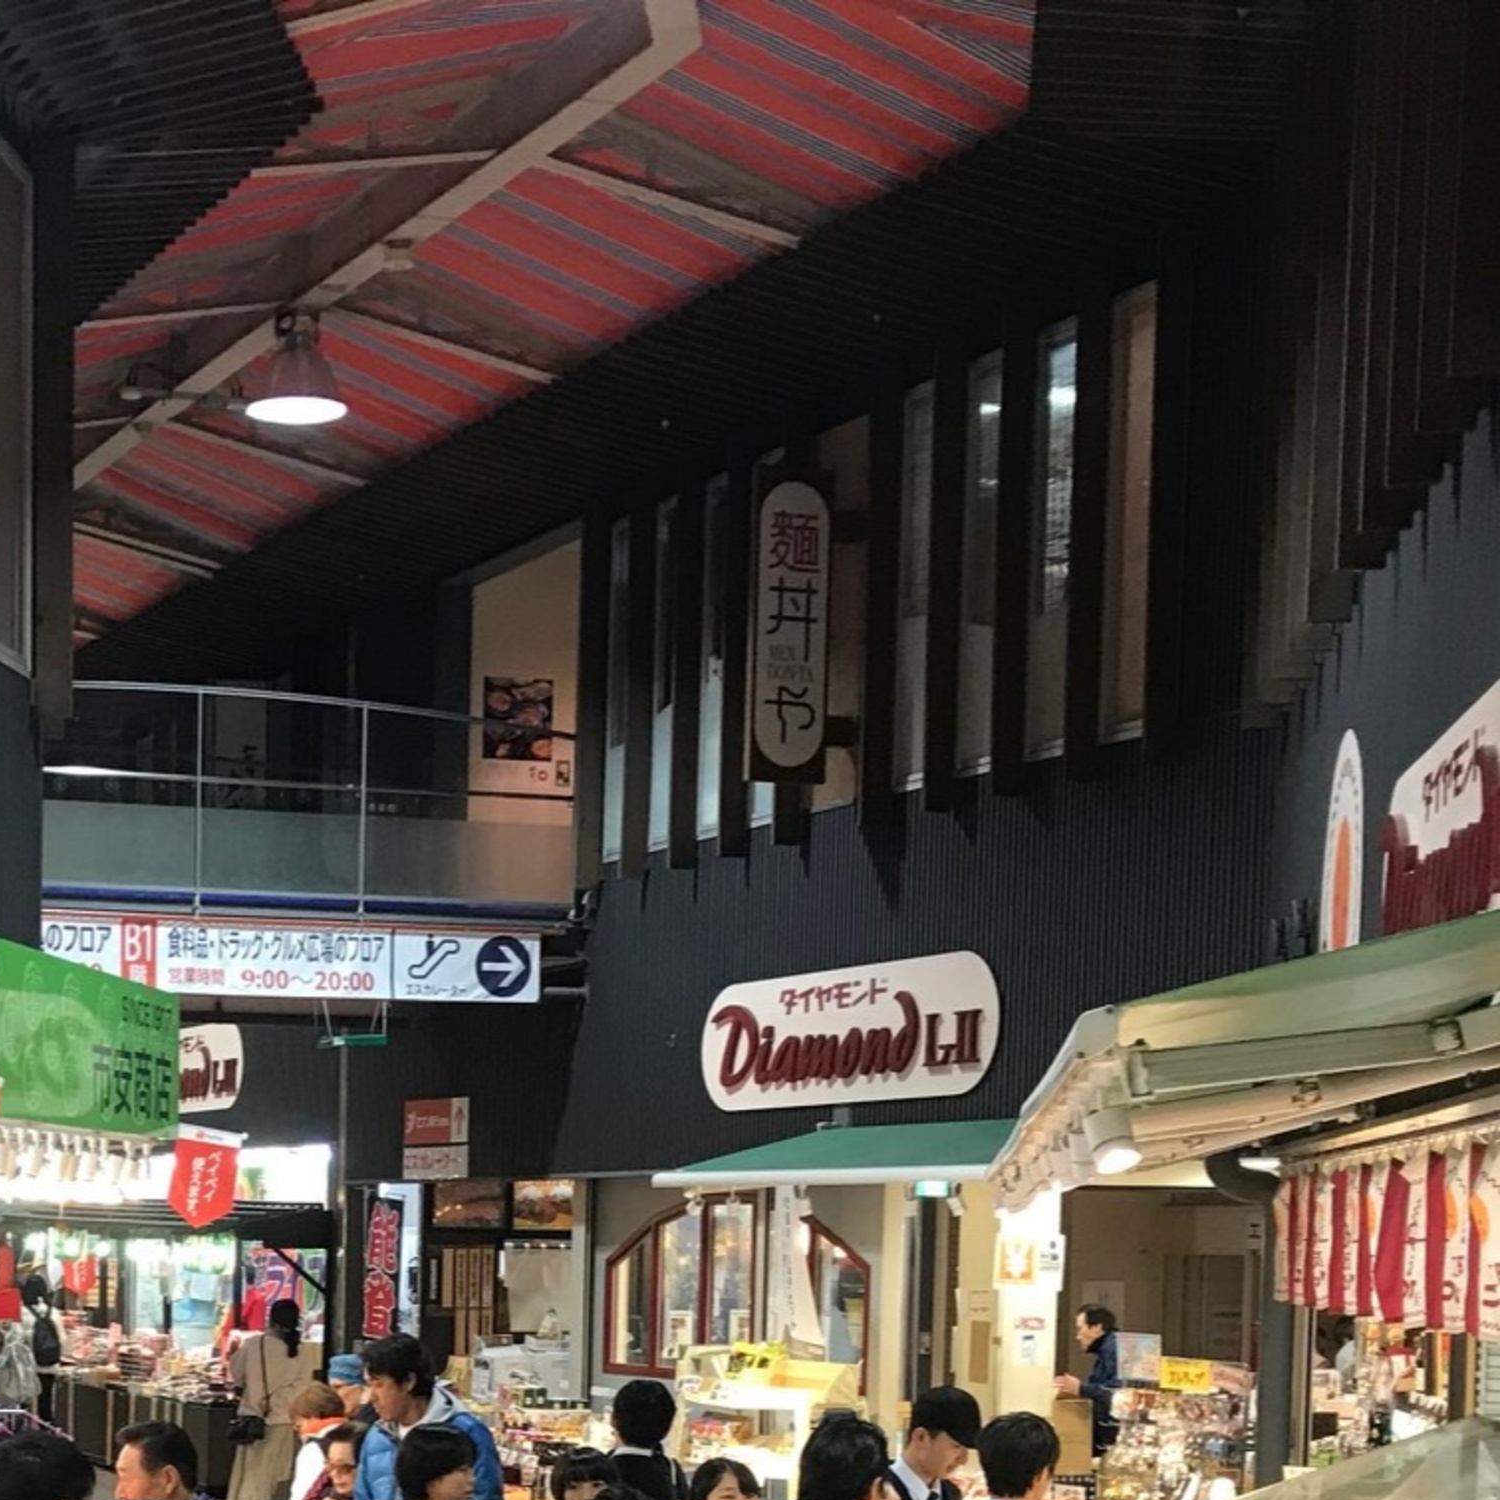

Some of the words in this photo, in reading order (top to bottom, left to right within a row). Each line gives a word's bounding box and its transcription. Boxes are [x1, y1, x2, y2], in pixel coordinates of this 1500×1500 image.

[41, 924, 112, 953] のフロア
[123, 922, 152, 962] B1
[779, 977, 889, 1015] ダイヤモンド
[710, 990, 921, 1088] Diamond
